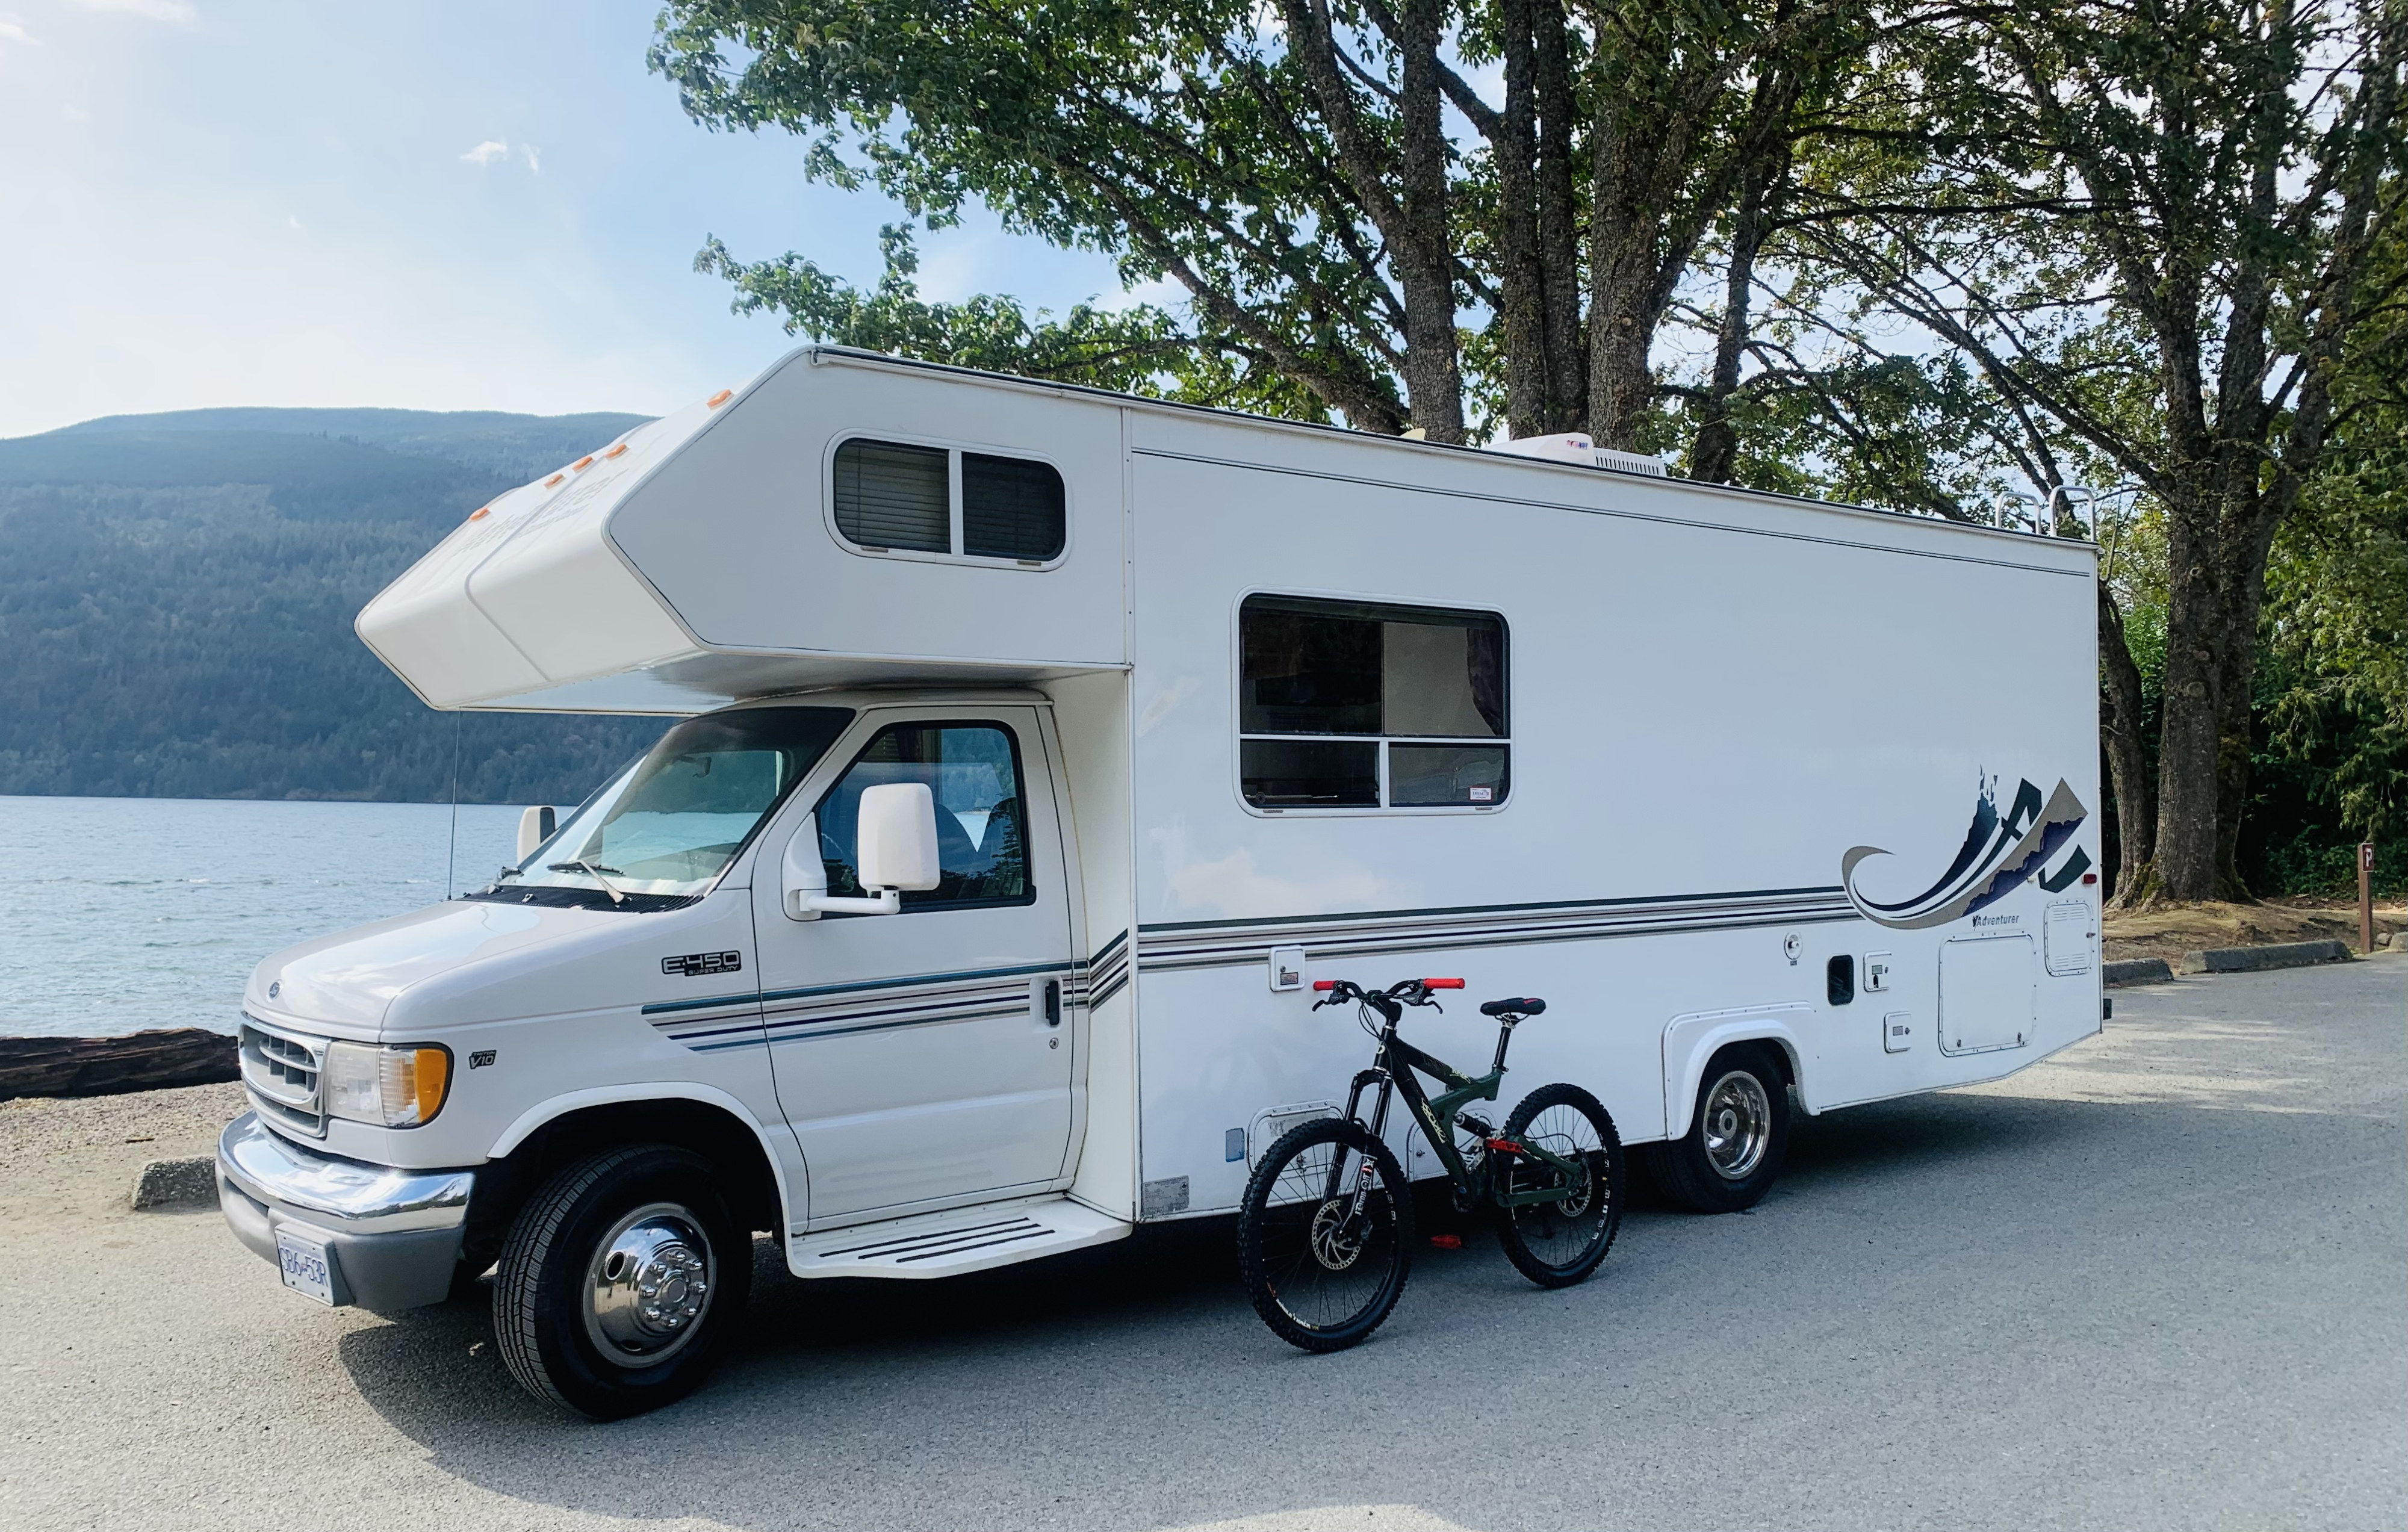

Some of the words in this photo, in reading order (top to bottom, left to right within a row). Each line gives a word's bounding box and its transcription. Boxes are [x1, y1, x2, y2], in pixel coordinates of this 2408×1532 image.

[2365, 848, 2372, 867] P
[1976, 915, 2019, 926] Adventurer
[688, 966, 715, 975] SUPER
[470, 1055, 494, 1069] V10
